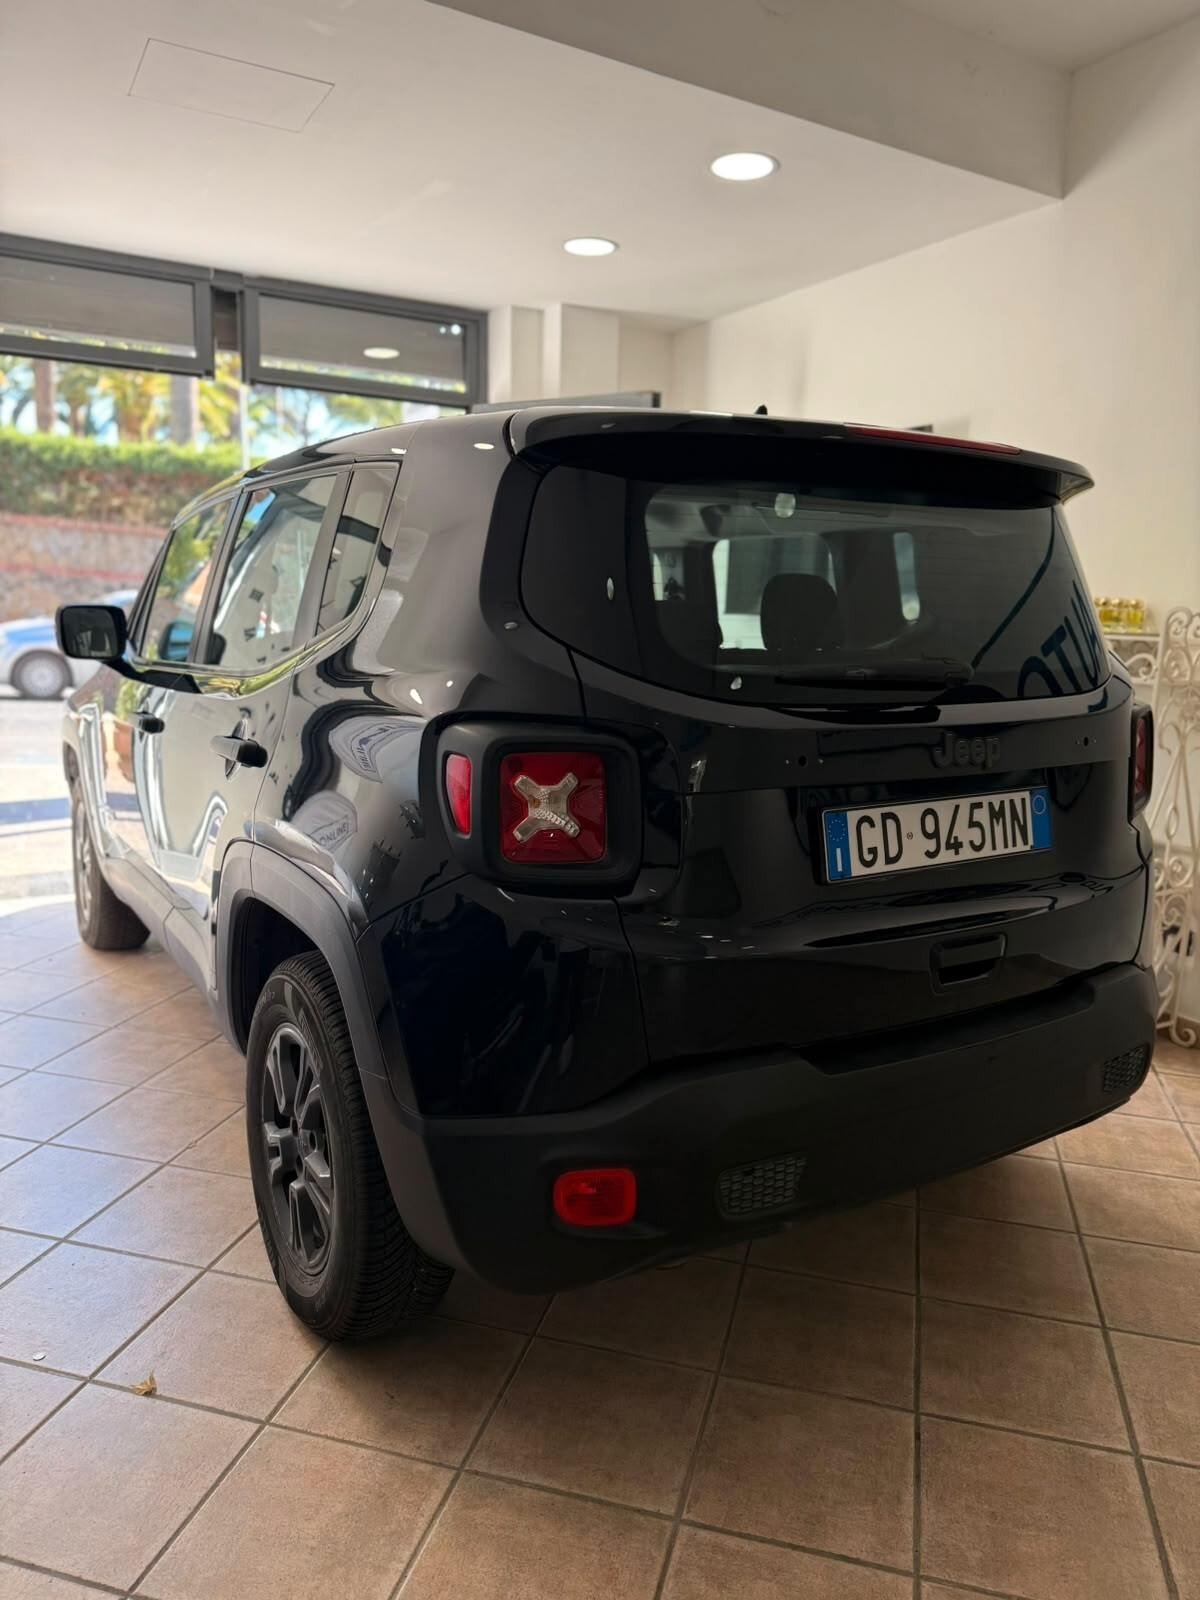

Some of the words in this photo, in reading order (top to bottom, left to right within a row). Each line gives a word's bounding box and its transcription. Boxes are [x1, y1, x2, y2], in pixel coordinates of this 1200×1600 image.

[930, 732, 1000, 772] Jeep
[855, 811, 904, 868] GD
[920, 797, 1030, 860] 945MN
